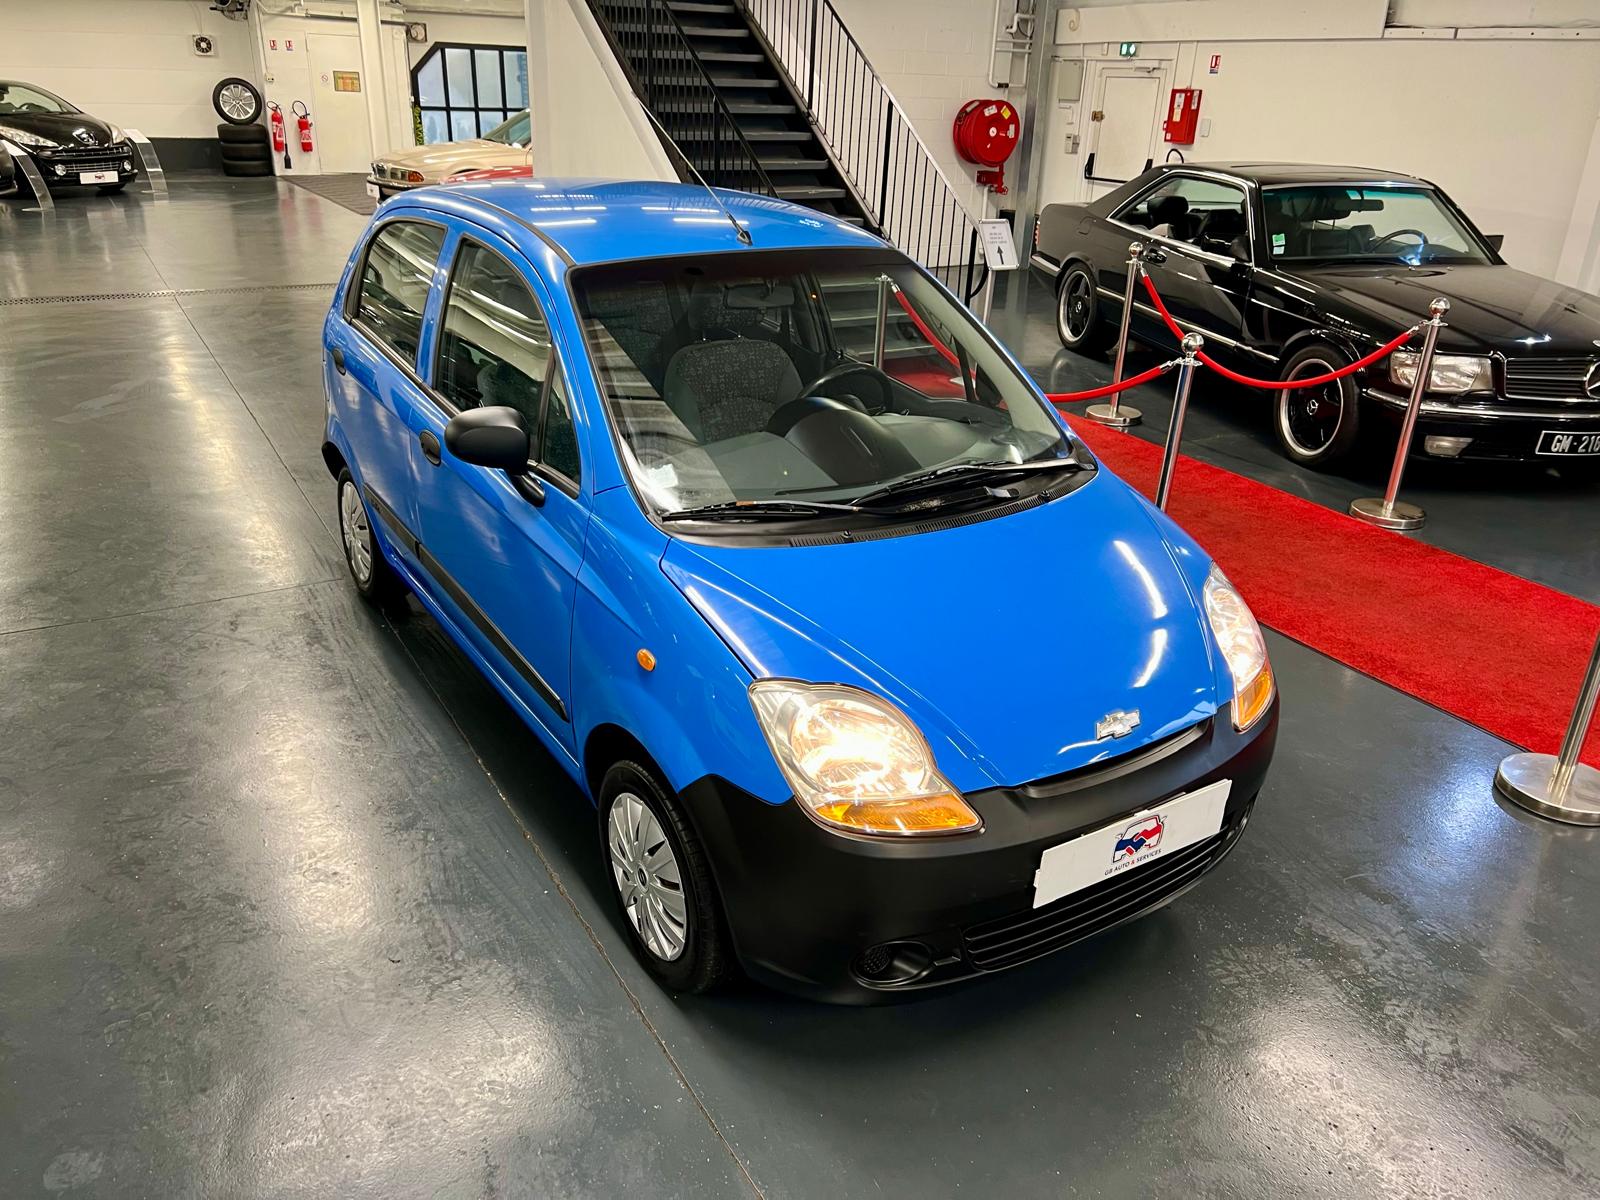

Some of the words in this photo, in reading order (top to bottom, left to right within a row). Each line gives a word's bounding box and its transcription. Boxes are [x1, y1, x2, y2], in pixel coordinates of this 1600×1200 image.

[1104, 868, 1113, 876] GB
[1114, 861, 1130, 872] AUTO
[1136, 849, 1162, 863] SERVICES
